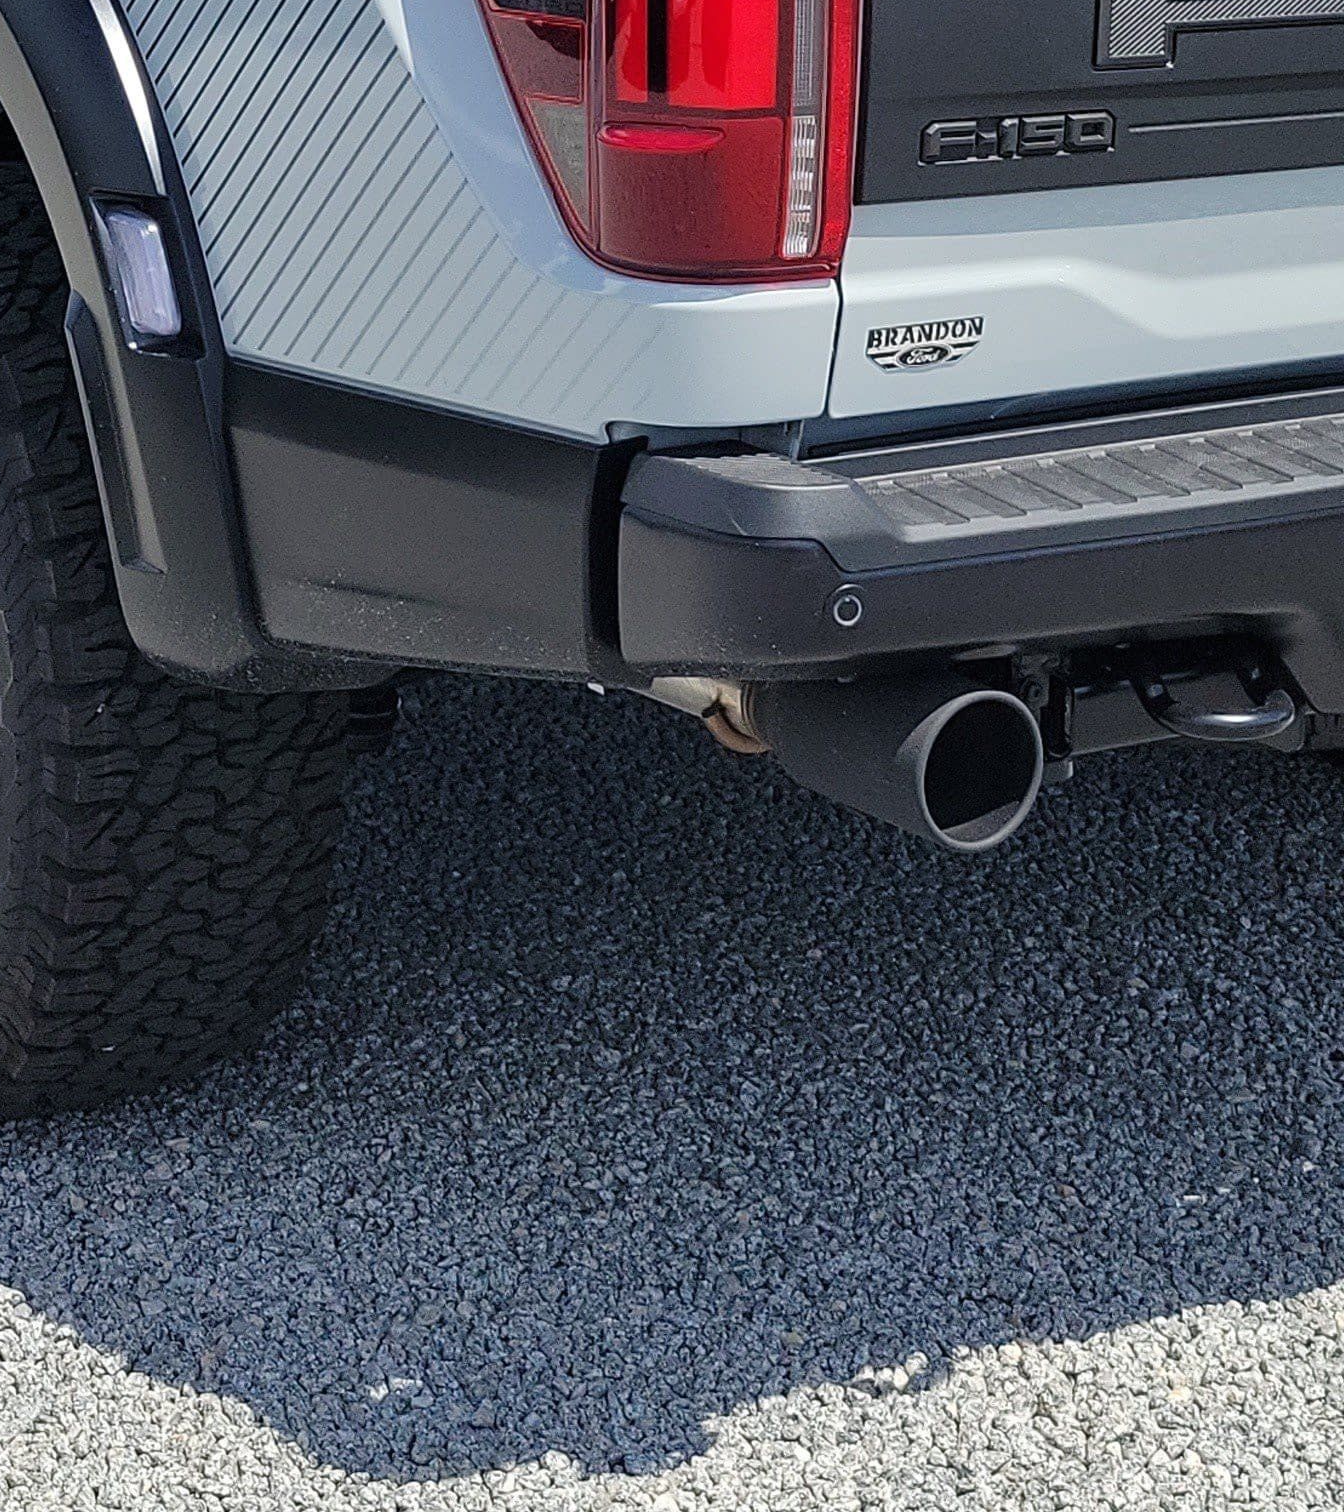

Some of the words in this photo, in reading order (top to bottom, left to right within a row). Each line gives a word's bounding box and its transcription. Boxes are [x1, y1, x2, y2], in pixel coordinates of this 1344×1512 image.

[920, 109, 1116, 165] F-150
[866, 316, 984, 349] BRANDON
[905, 347, 941, 365] Ford
